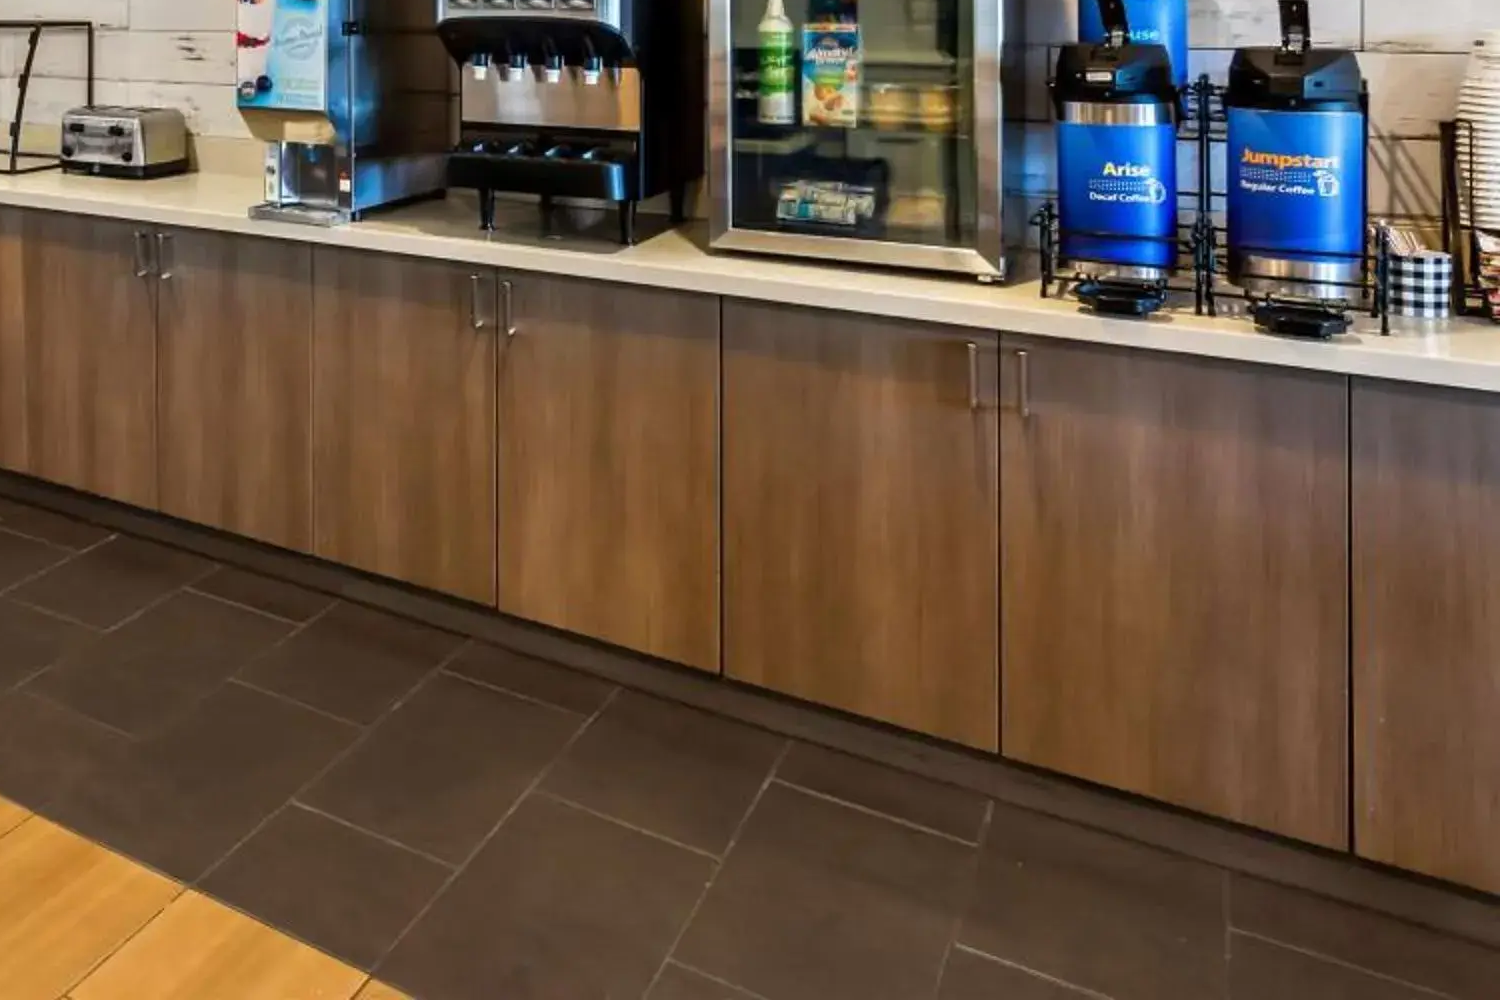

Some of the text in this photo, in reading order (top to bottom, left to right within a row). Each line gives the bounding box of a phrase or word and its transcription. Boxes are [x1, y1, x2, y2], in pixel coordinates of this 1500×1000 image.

[1241, 149, 1340, 169] Jumpstart
[1103, 161, 1152, 177] Arise
[1278, 184, 1316, 195] Coffee
[1089, 192, 1118, 202] Decaf
